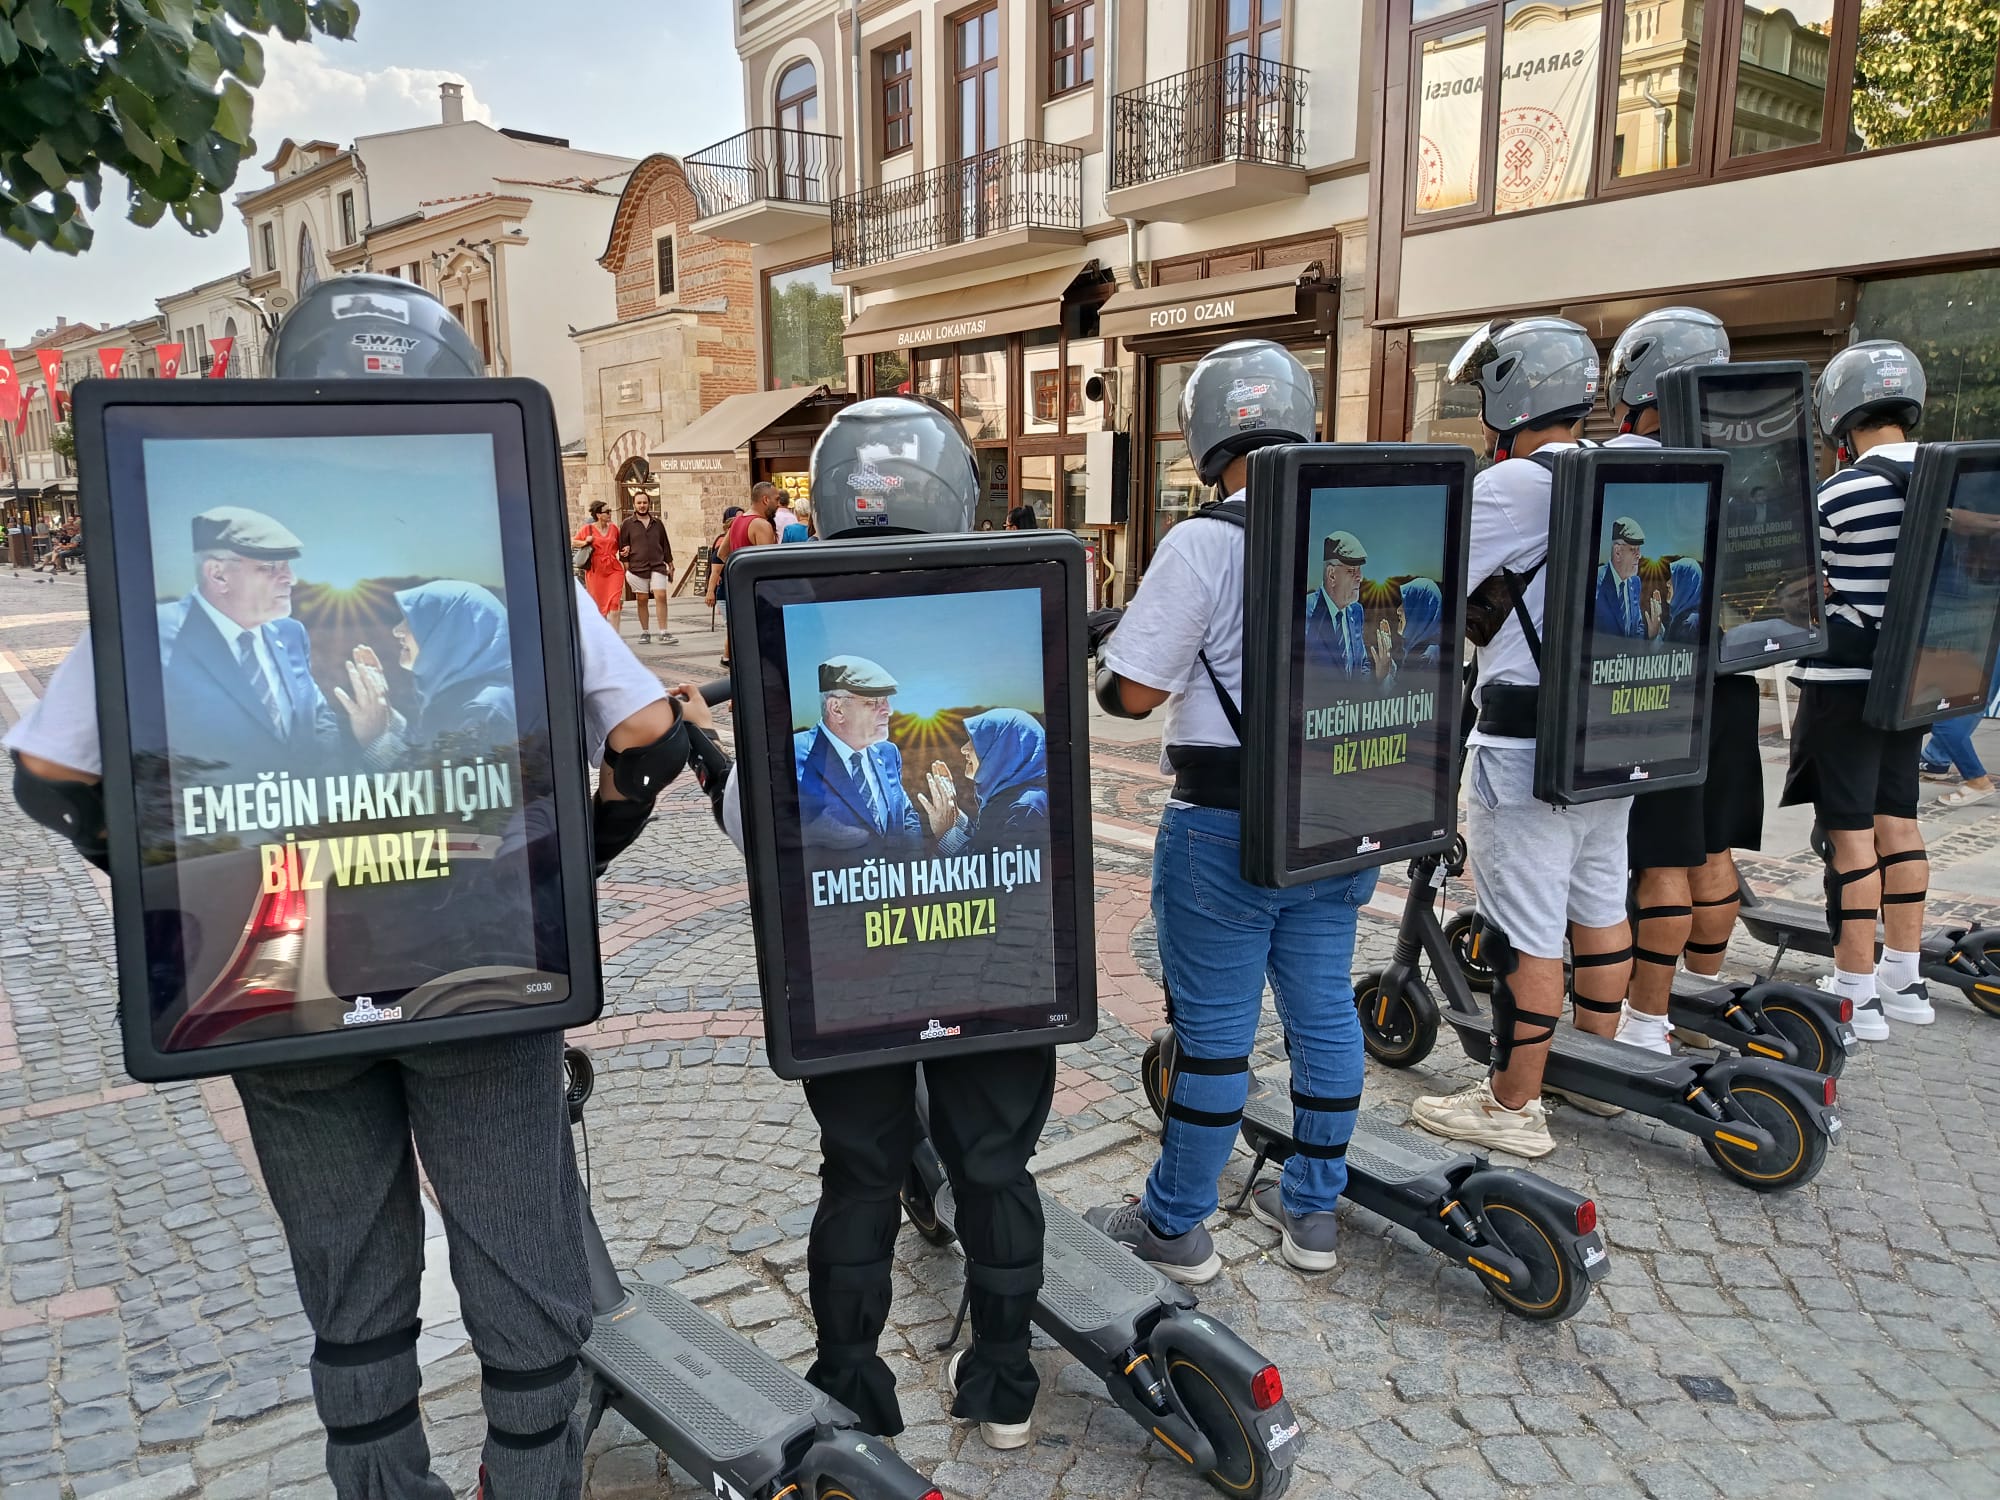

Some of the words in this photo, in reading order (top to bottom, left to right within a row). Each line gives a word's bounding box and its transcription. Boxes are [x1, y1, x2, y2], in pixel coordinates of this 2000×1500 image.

[1150, 307, 1187, 328] FOTO
[1194, 300, 1235, 321] OZAN
[353, 334, 418, 349] SWAY
[898, 324, 932, 345] BALKAN
[936, 319, 986, 340] LOKANTASI
[661, 458, 678, 470] NEHİR
[680, 458, 722, 470] KUYUMCULUK
[1592, 654, 1634, 685] EMEĞİN
[1635, 654, 1670, 680] HAKKI
[1671, 649, 1693, 681] İÇİN
[1611, 685, 1632, 715] BİZ
[1634, 684, 1670, 712] VARIZ!
[1306, 700, 1359, 740] EMEĞİN
[1361, 697, 1404, 731] HAKKI
[1407, 689, 1433, 728] İÇİN
[1333, 738, 1357, 775] BİZ
[1360, 733, 1407, 770] VARIZ!
[183, 771, 319, 835] EMEĞİN
[326, 769, 436, 823] HAKKI
[442, 757, 512, 821] İÇİN
[261, 833, 323, 894] BİZ
[328, 829, 450, 887] VARIZ!
[812, 859, 906, 907] EMEĞİN
[911, 854, 987, 895] HAKKI
[992, 845, 1041, 893] İÇİN
[865, 903, 907, 948] BİZ
[912, 898, 996, 942] VARIZ!
[526, 982, 552, 993] SC030
[344, 1007, 402, 1025] ScootAd
[1050, 1014, 1068, 1022] SC011
[920, 1026, 960, 1040] ScootAd
[673, 1350, 712, 1379] ninebot
